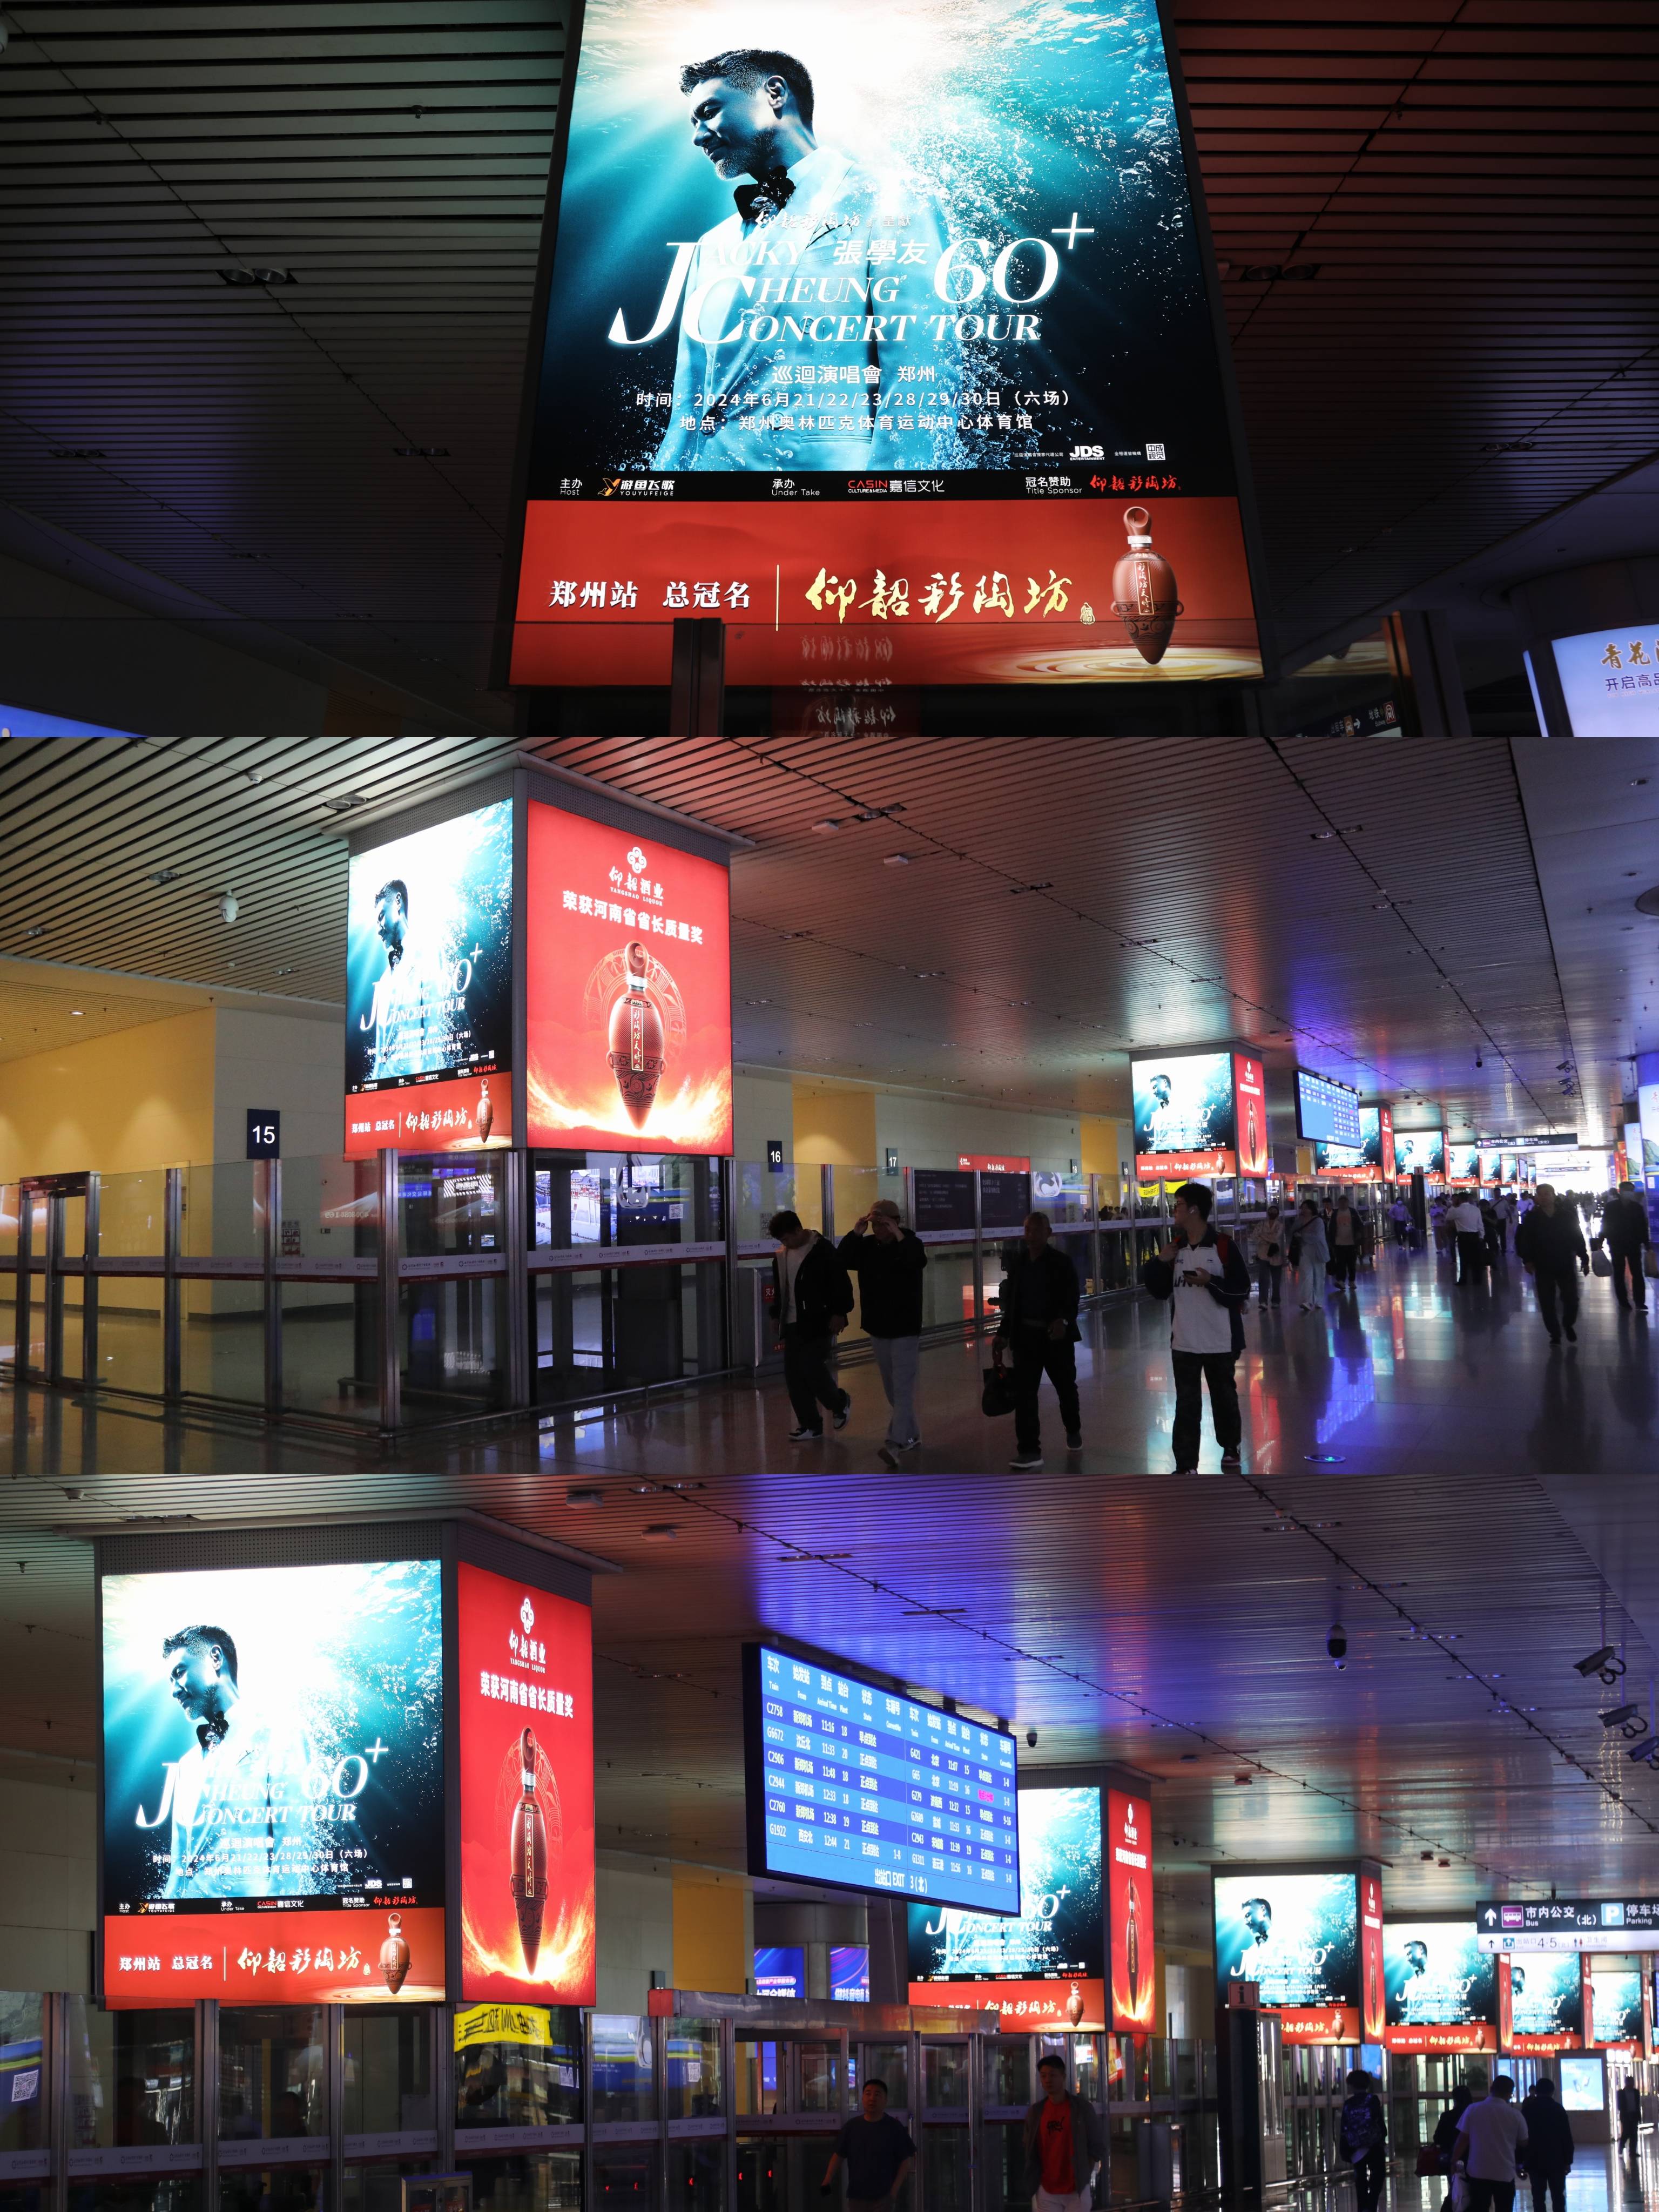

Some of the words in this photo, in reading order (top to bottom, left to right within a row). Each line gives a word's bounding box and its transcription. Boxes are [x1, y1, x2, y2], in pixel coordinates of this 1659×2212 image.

[833, 240, 929, 265] 張學友
[929, 313, 1042, 341] TOUR
[772, 365, 882, 385] 巡迴演唱會
[898, 366, 935, 382] 郑州
[1069, 445, 1105, 457] JDS
[560, 478, 583, 488] 主办
[621, 480, 675, 490] 游鱼飞歌
[772, 478, 795, 489] 承办
[848, 480, 887, 488] CASIN
[889, 480, 945, 493] 嘉信文化
[1026, 477, 1070, 487] 冠名赞助
[1090, 475, 1177, 492] 仰韶彩陶坊
[1026, 487, 1048, 495] Title
[1049, 487, 1082, 495] Sponsor
[549, 580, 638, 608] 郑州站
[663, 581, 750, 609] 总冠名
[805, 567, 1073, 624] 仰韶彩陶坊
[1601, 639, 1659, 669] 青花
[609, 866, 664, 899] 仰韶酒业
[610, 886, 639, 899] YANGSHAO
[643, 896, 663, 906] LIQUOR
[563, 890, 703, 945] 荣获河南省省长质量奖
[406, 1107, 468, 1133] 仰韶彩陶坊
[252, 1125, 275, 1144] 15
[771, 1150, 781, 1163] 16
[889, 1157, 896, 1167] 17
[509, 1629, 546, 1664] 仰韶酒业
[510, 1658, 529, 1669] YANGSHAO
[532, 1664, 545, 1674] LIQUOR
[767, 1656, 779, 1674] 车次
[793, 1665, 810, 1685] 始发站
[821, 1675, 832, 1692] 到点
[838, 1681, 848, 1698] 站台
[769, 1681, 779, 1691] Train
[481, 1671, 573, 1718] 荣获河南省省长质量奖
[767, 1702, 783, 1717] C2758
[793, 1710, 812, 1728] 新郑机场
[821, 1720, 834, 1733] 11:16
[841, 1725, 847, 1737] 18
[909, 1707, 919, 1722] 车次
[767, 1727, 784, 1741] G6672
[822, 1743, 835, 1756] 11:33
[842, 1749, 848, 1759] 20
[860, 1753, 877, 1769] 正点到达
[768, 1751, 784, 1765] C2906
[794, 1757, 813, 1774] 新郑机场
[823, 1766, 835, 1779] 11:48
[842, 1771, 848, 1782] 18
[965, 1765, 969, 1775] 15
[768, 1775, 785, 1789] C2944
[795, 1781, 814, 1797] 新郑机场
[824, 1789, 835, 1802] 12:33
[843, 1794, 849, 1804] 18
[965, 1785, 970, 1795] 16
[297, 1804, 356, 1822] TOUR
[769, 1799, 785, 1813] C2760
[795, 1805, 814, 1821] 新郑机场
[824, 1812, 837, 1825] 12:38
[844, 1816, 849, 1827] 19
[949, 1800, 959, 1812] 11:22
[966, 1805, 970, 1815] 15
[770, 1824, 786, 1837] G1922
[799, 1829, 813, 1844] 西安北
[825, 1836, 837, 1847] 12:44
[844, 1839, 850, 1850] 21
[966, 1825, 970, 1835] 16
[967, 1845, 971, 1854] 19
[875, 1868, 892, 1887] 出站口
[892, 1872, 905, 1887] EXIT
[967, 1866, 972, 1874] 16
[1526, 1906, 1575, 1918] 市内公交
[1526, 1919, 1539, 1927] Bus
[1626, 1918, 1653, 1926] Parking
[119, 1957, 160, 1972] 郑州站
[171, 1955, 213, 1970] 总冠名
[237, 1947, 362, 1976] 仰韶彩陶坊
